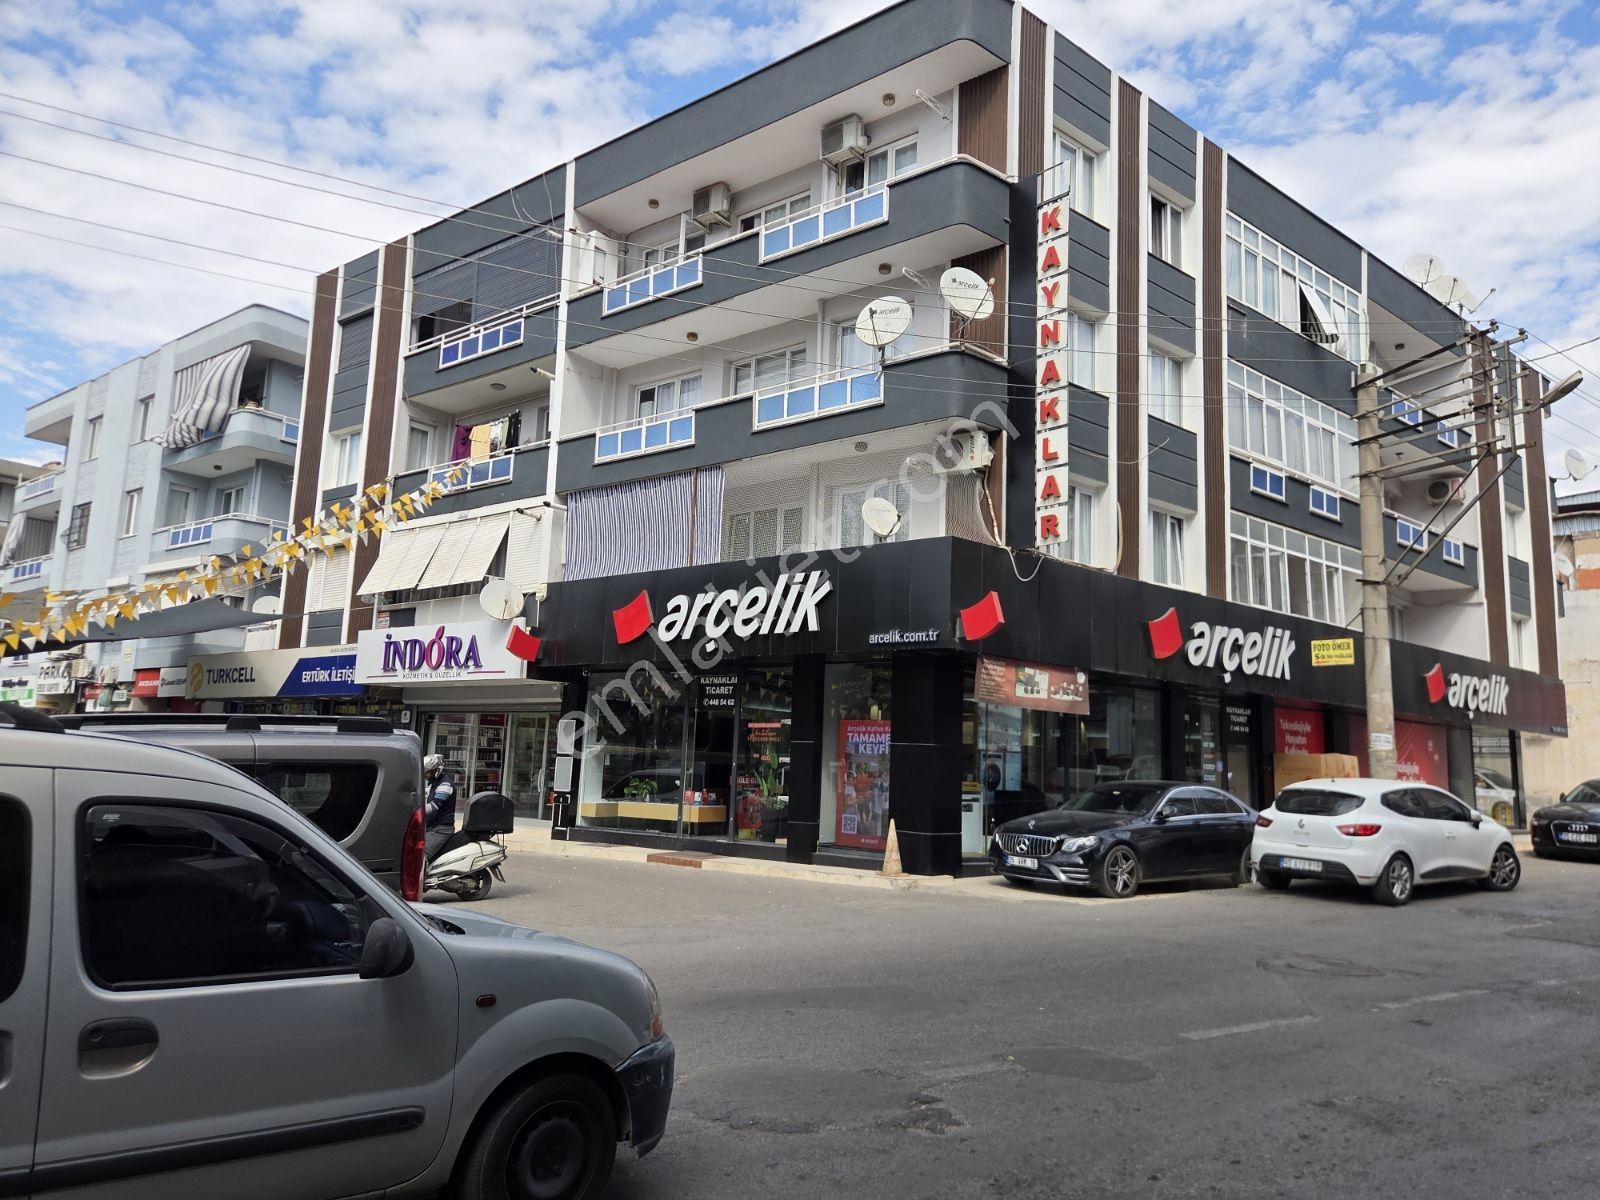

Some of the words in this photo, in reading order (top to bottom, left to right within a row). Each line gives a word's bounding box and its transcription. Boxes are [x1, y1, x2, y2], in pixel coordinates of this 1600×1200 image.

[1039, 205, 1062, 540] KAYNAKLAR
[658, 570, 833, 653] arçelik
[869, 629, 939, 644] arcelik.com.tr
[1186, 621, 1296, 684] arçelik
[206, 667, 255, 684] TURKCELL
[302, 668, 330, 683] ERTÜRK
[331, 666, 357, 685] İLETİŞİ
[1447, 672, 1509, 720] arçelik
